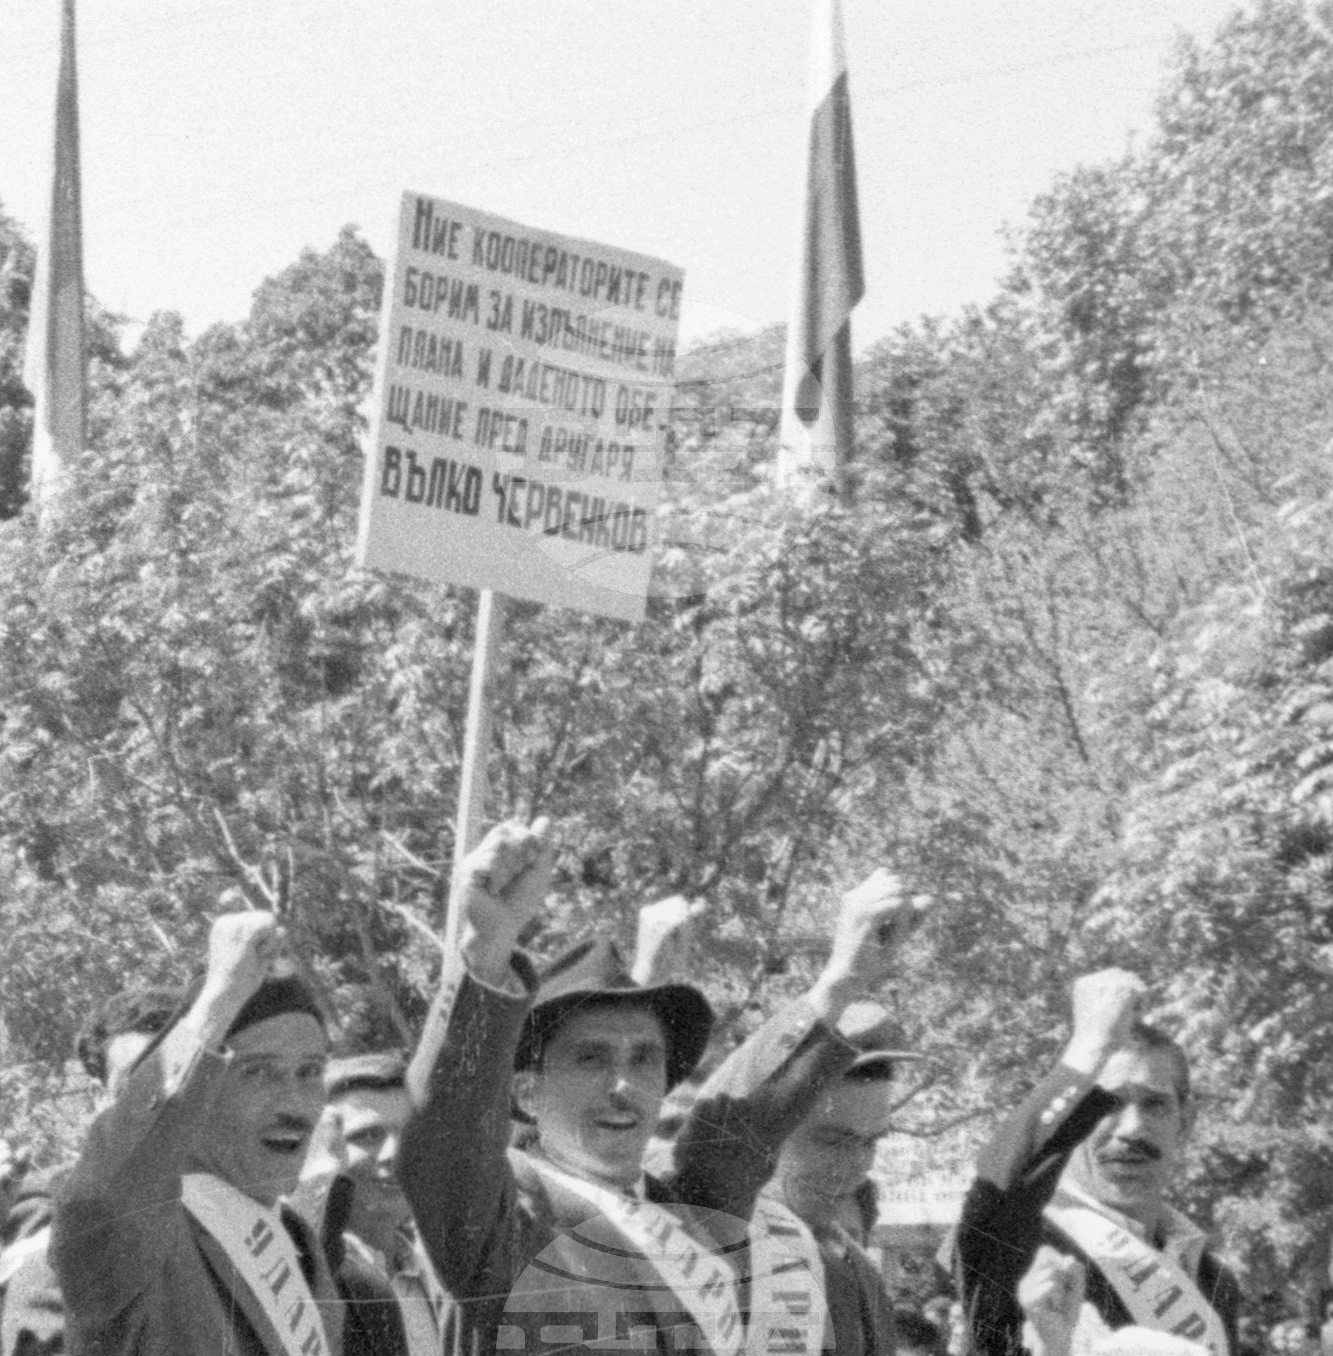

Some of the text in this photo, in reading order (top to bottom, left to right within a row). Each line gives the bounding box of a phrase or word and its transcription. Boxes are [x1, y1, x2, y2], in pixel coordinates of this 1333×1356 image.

[412, 196, 462, 260] НИЕ
[472, 227, 650, 311] КООПЕРАТОРИТЕ
[403, 266, 480, 324] БОРИМ
[487, 290, 513, 334] ЗА
[396, 326, 463, 378] ПЛАНА
[476, 347, 491, 388] И
[386, 384, 468, 440] ЩАНИЕ
[474, 407, 528, 456] ПРЕД
[381, 446, 647, 554] ВЪЛКО ЧЕРВЕНКОВ
